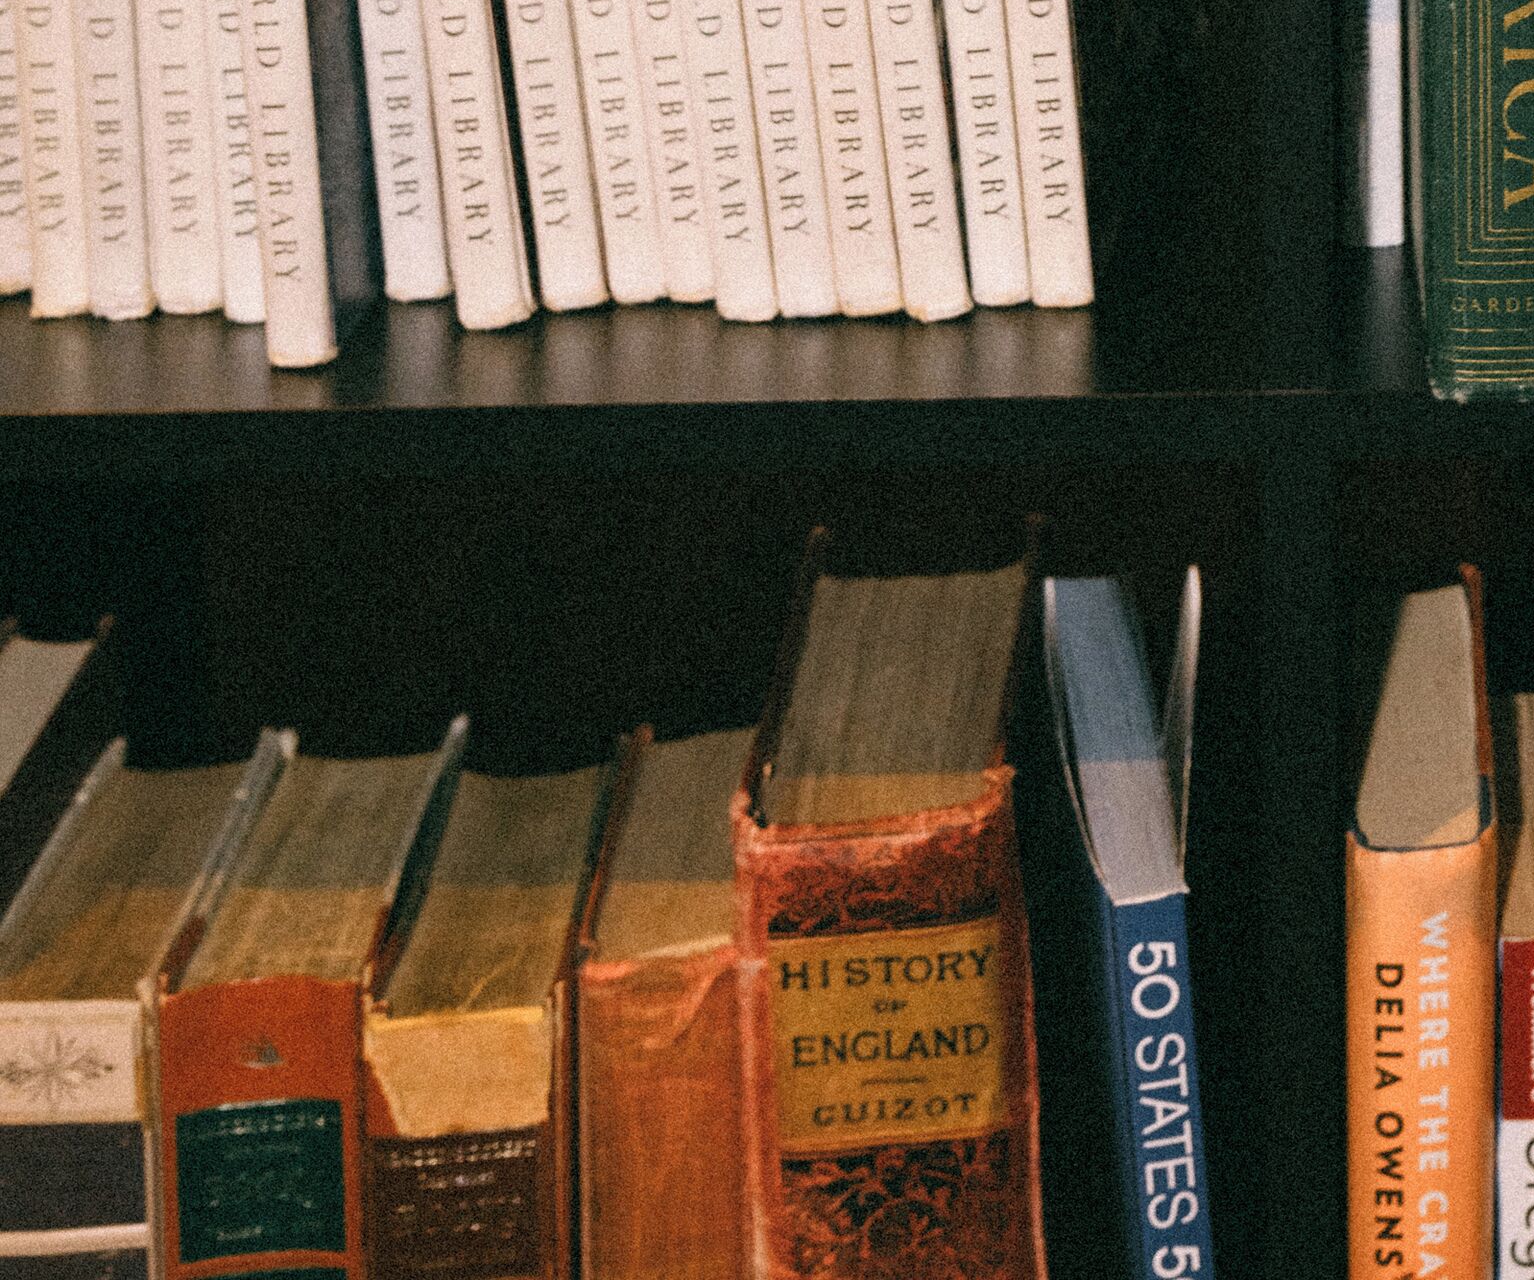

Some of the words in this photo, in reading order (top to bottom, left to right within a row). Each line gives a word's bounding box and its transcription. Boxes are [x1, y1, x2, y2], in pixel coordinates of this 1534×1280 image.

[378, 45, 425, 224] LIBRARY
[827, 60, 875, 237] LIBRARY
[1030, 48, 1073, 226] LIBRARY
[780, 943, 994, 992] HISTORY
[873, 997, 906, 1015] OF
[1127, 939, 1181, 1020] 50
[1375, 962, 1404, 1090] DELIA
[1418, 910, 1450, 1071] WHERE
[791, 1023, 991, 1069] ENGLAND
[812, 1093, 977, 1127] GUIZOT
[1134, 1032, 1200, 1230] STATES
[1375, 1111, 1404, 1267] OWENS
[1418, 1085, 1449, 1173] THE
